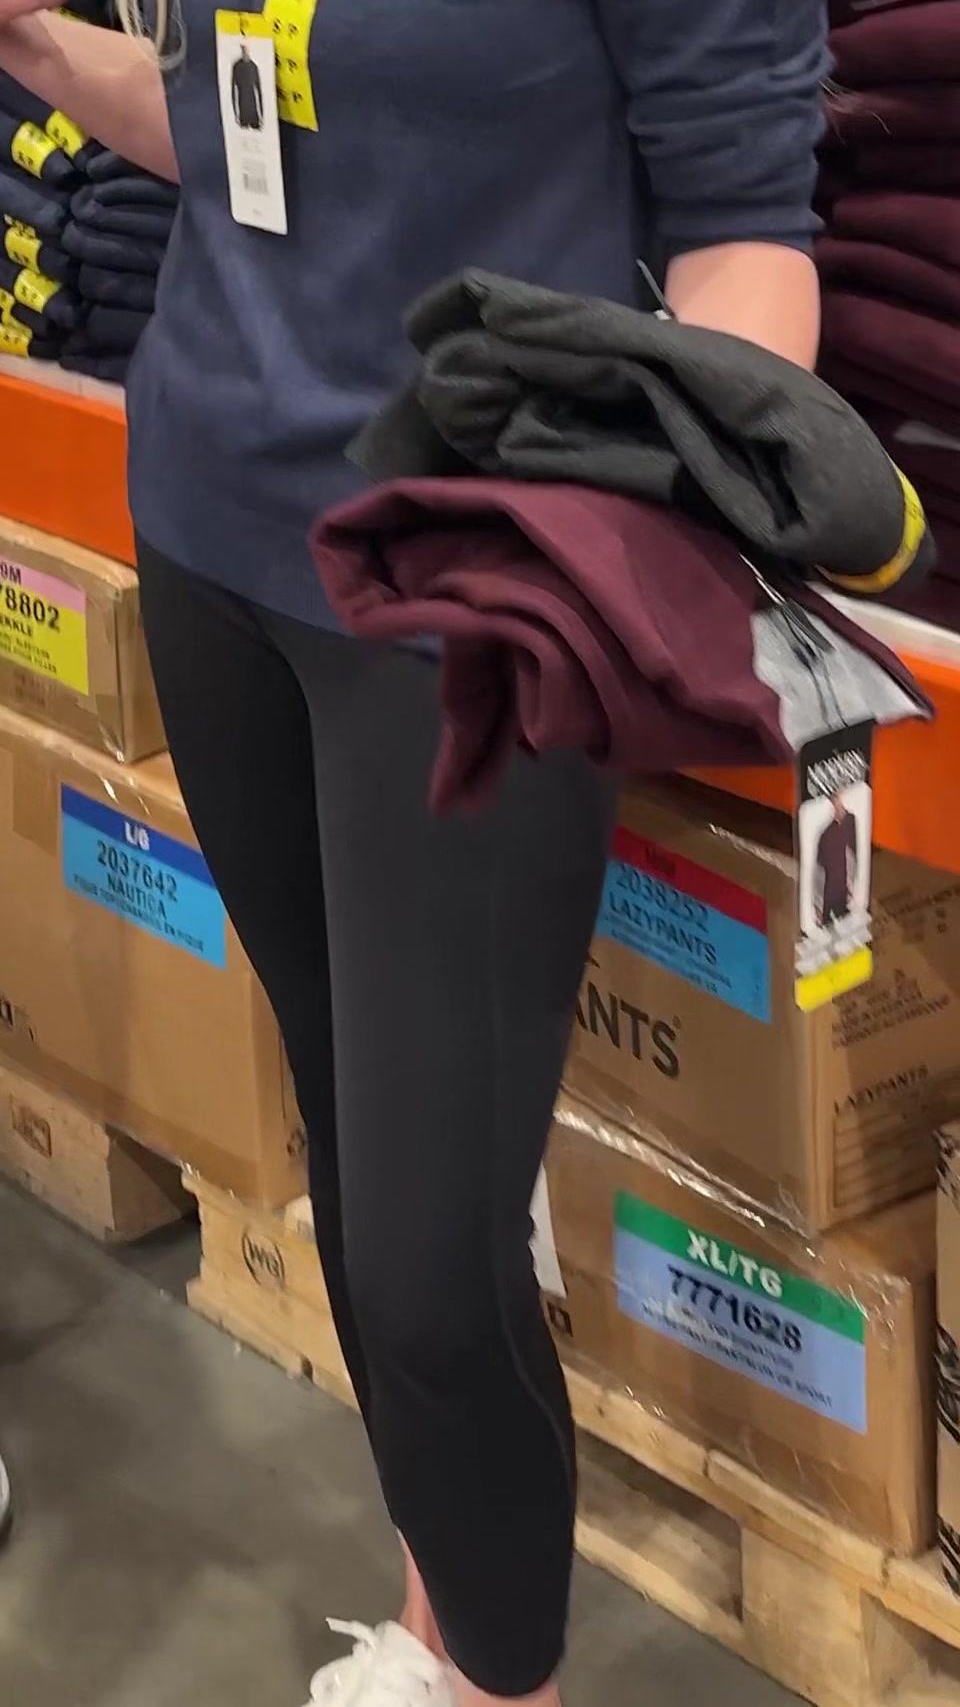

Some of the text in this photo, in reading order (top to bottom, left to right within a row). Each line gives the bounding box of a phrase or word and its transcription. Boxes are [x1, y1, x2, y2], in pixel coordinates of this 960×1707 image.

[97, 839, 178, 904] 2037642
[107, 872, 168, 920] NAUTICA
[608, 890, 717, 966] LAZYPANTS
[686, 1229, 784, 1299] XL/TG
[667, 1262, 803, 1355] 7771628
